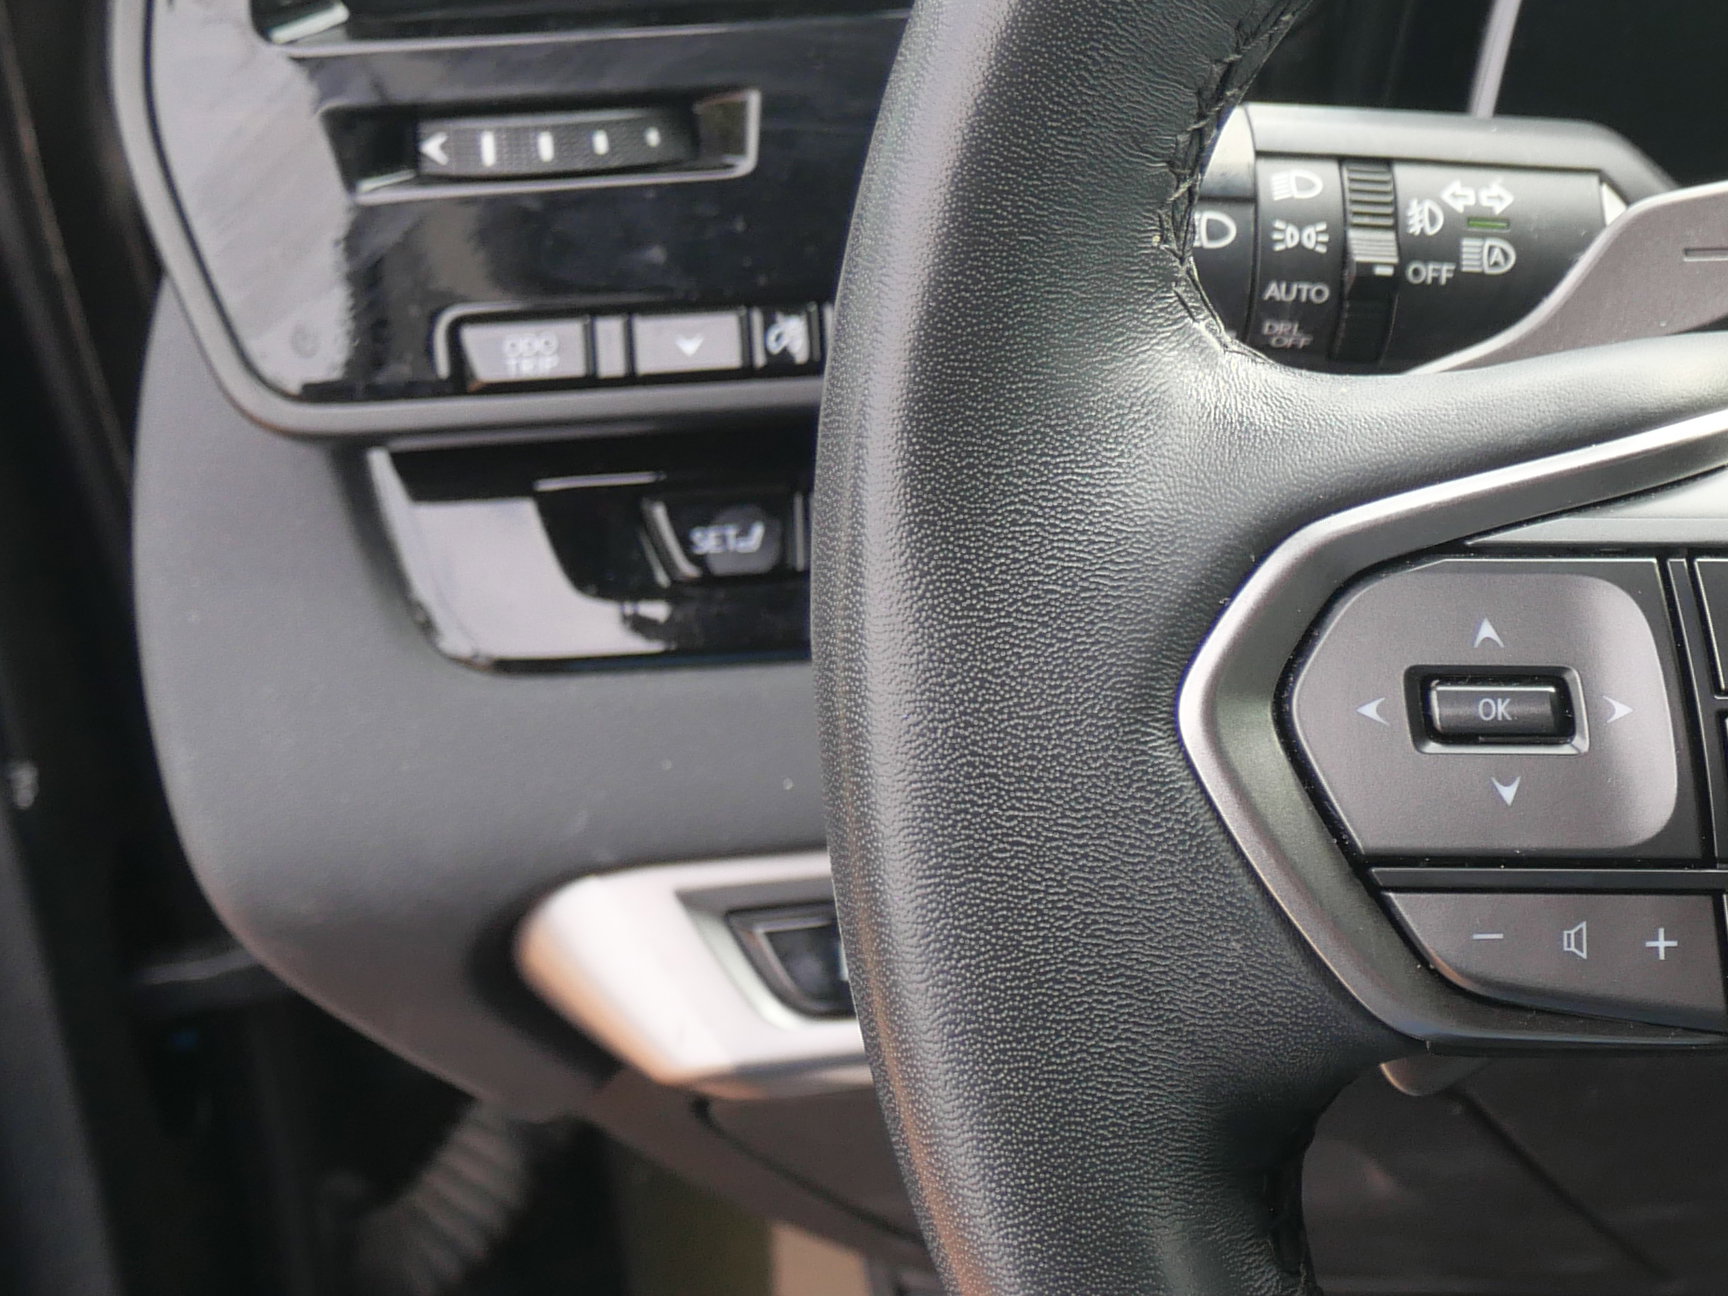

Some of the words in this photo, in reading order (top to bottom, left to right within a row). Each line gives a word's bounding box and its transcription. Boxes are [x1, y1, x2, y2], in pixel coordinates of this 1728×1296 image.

[1406, 260, 1456, 286] OFF
[1262, 281, 1330, 304] AUTO
[1261, 319, 1303, 336] DRL
[1269, 334, 1313, 349] OFF
[689, 524, 737, 555] SET
[1479, 698, 1512, 721] OK
